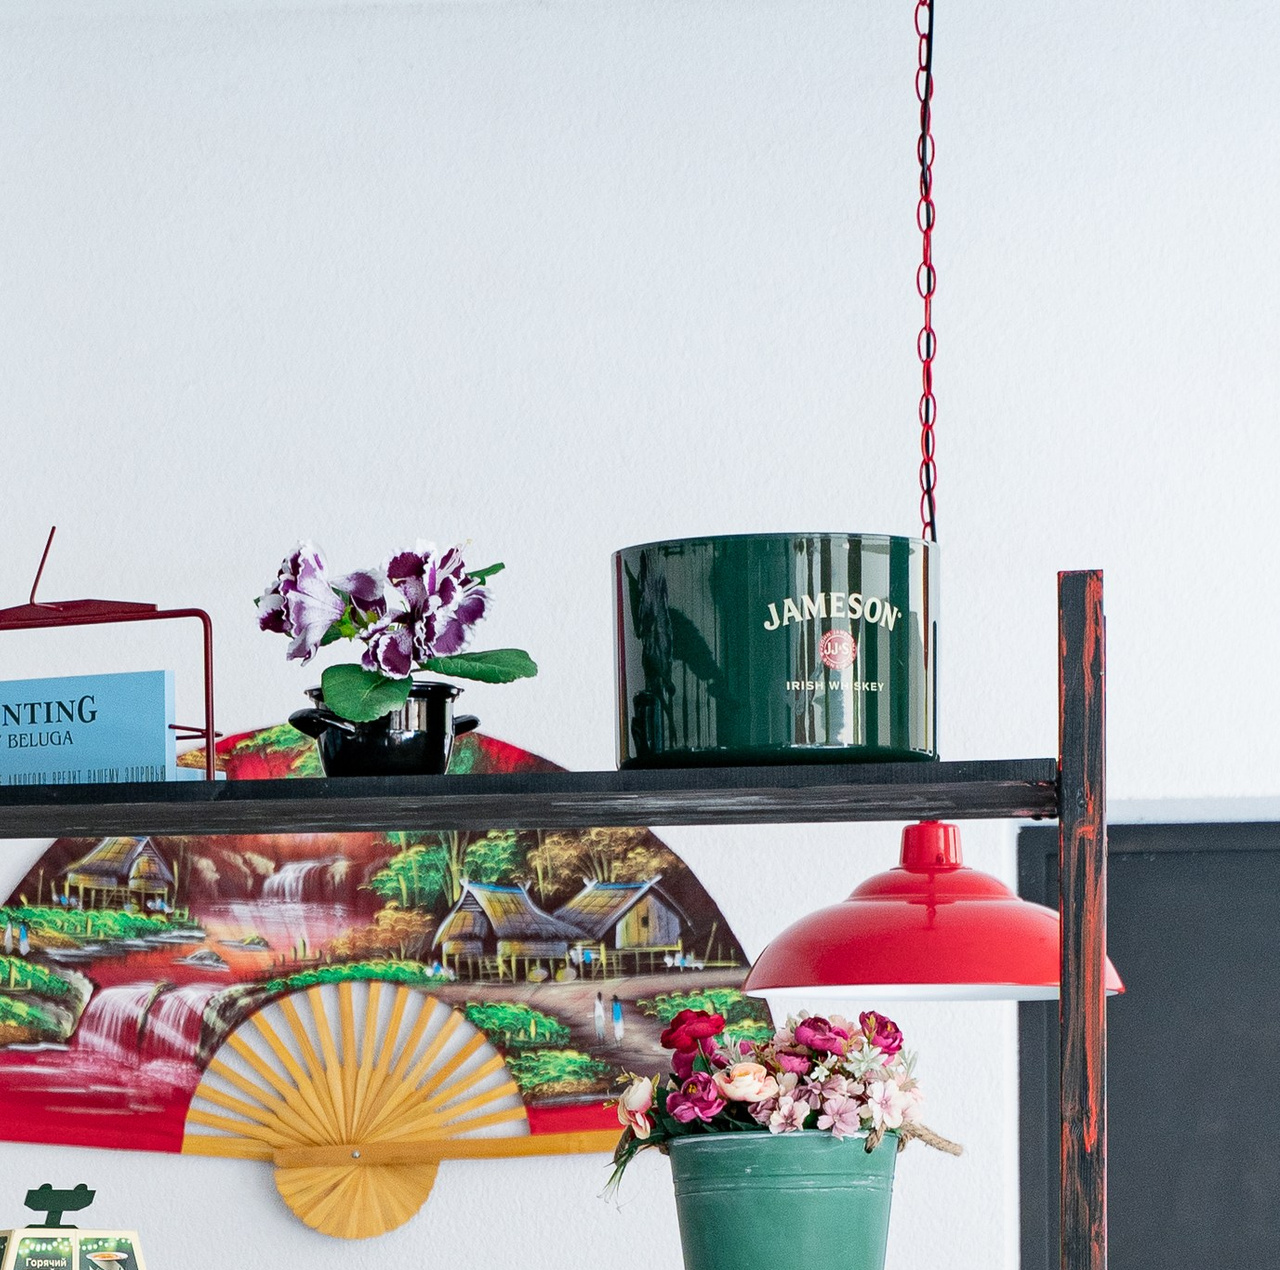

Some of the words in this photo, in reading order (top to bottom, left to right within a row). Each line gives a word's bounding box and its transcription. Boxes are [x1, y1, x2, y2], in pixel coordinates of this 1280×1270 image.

[763, 592, 901, 631] JAMESON
[786, 681, 823, 691] IRISH
[8, 731, 73, 748] BELUGA
[25, 1257, 67, 1268] Горячий
